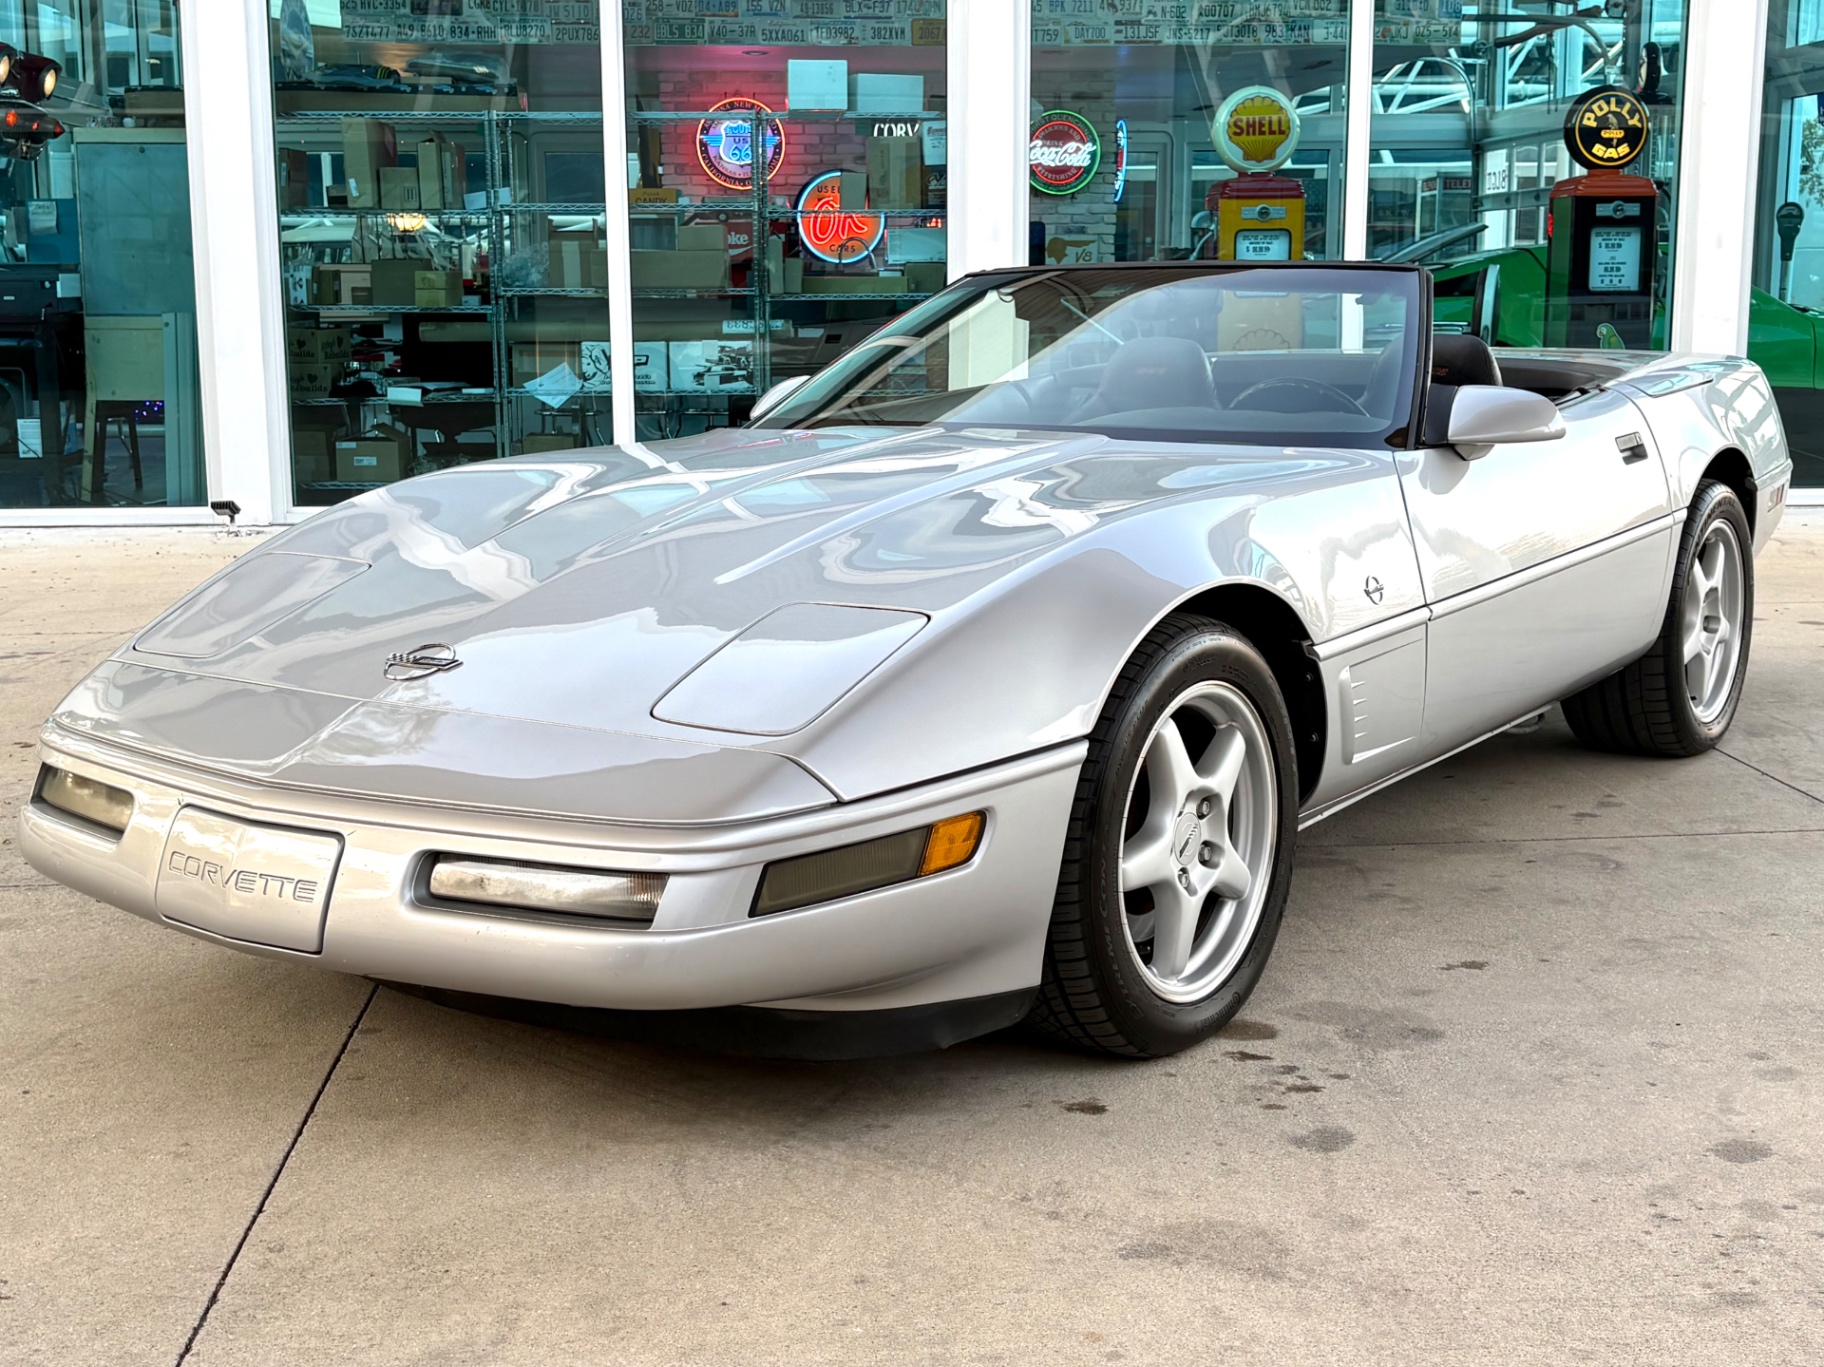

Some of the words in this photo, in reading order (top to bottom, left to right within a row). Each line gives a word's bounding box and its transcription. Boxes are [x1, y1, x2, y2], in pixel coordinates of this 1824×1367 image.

[1581, 97, 1643, 128] POLLY
[1232, 116, 1286, 137] SHELL
[733, 137, 749, 145] US
[1591, 142, 1631, 159] GAS
[729, 144, 753, 162] 66
[701, 152, 740, 187] CALIFORNIA
[1075, 248, 1093, 263] V8
[168, 850, 319, 904] CORVETTE
